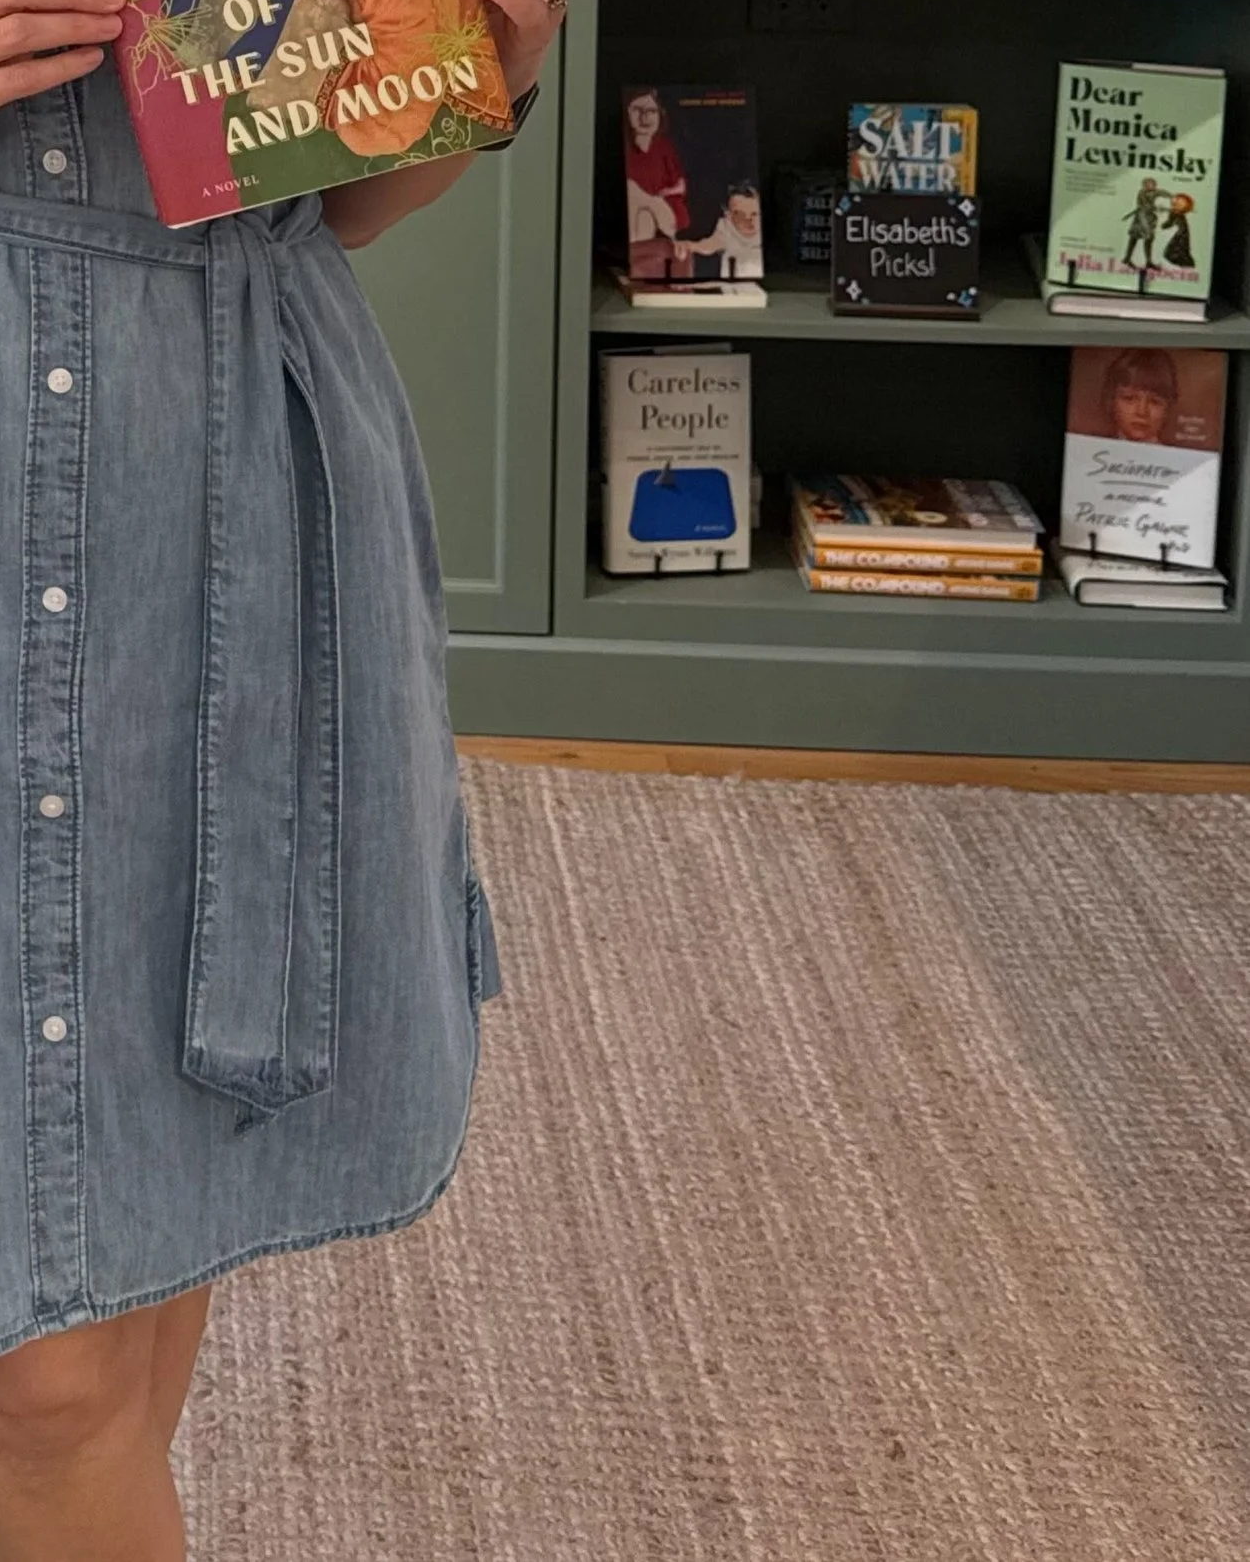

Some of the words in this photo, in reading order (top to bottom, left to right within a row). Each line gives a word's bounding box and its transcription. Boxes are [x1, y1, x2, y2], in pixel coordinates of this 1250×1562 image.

[171, 51, 267, 107] THE
[275, 21, 375, 79] SUN
[226, 98, 320, 156] AND
[334, 56, 480, 126] MOON
[1069, 76, 1143, 107] Dear
[858, 116, 962, 160] SALT
[1067, 107, 1179, 142] Monica
[857, 160, 957, 192] WATER
[1065, 137, 1213, 182] Lewinsky
[201, 186, 211, 199] A
[213, 175, 260, 196] NOVEL
[846, 216, 971, 246] Elisabeth's
[870, 247, 937, 277] Picks!
[627, 368, 741, 394] Careless
[640, 403, 729, 438] People
